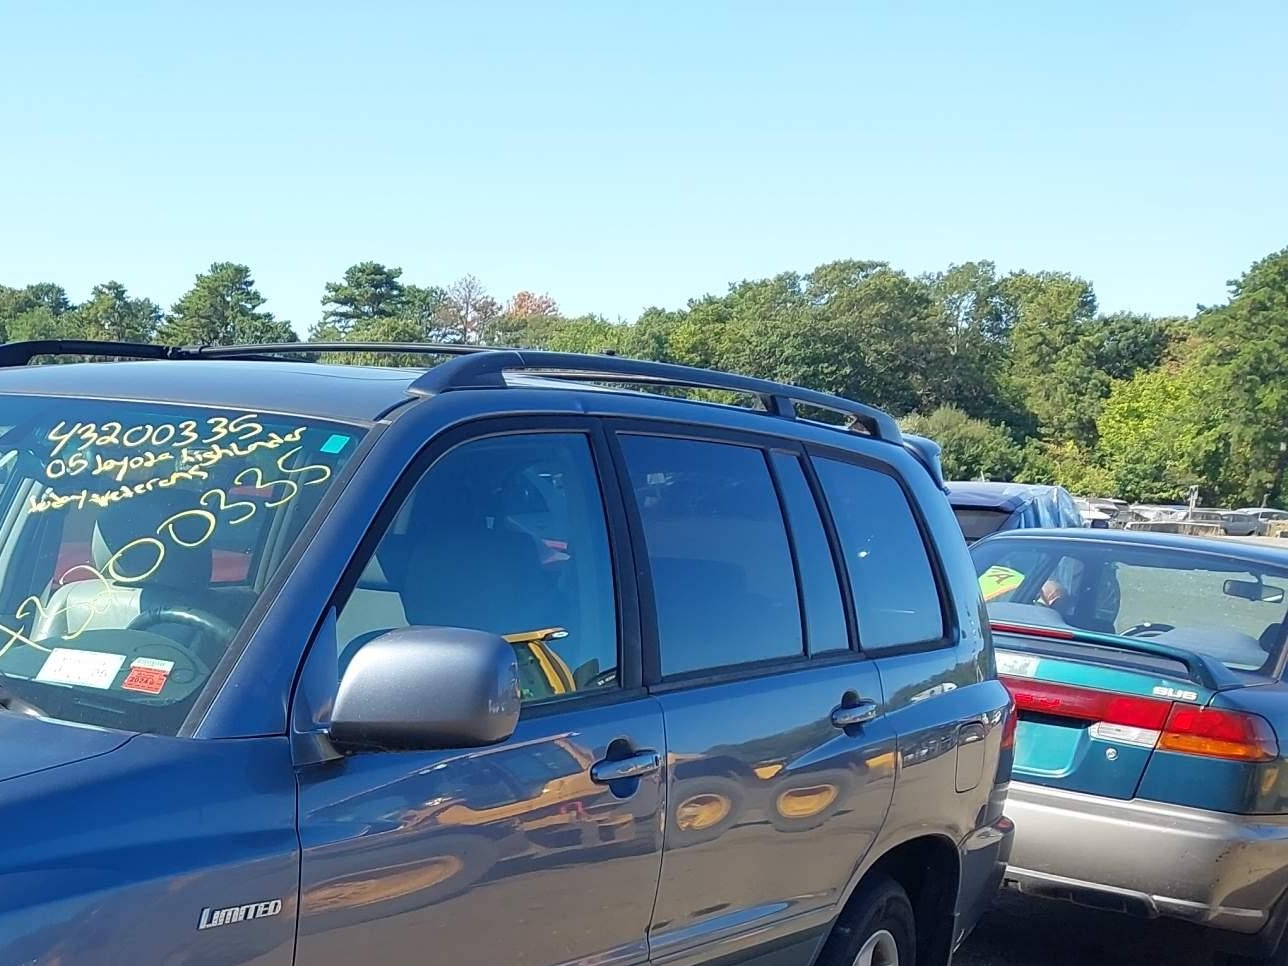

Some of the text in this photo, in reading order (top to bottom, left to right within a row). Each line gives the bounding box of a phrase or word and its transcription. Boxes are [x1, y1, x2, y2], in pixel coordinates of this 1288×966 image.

[47, 414, 263, 457] 43200335
[45, 452, 88, 478] 05
[198, 899, 282, 930] LIMITED
